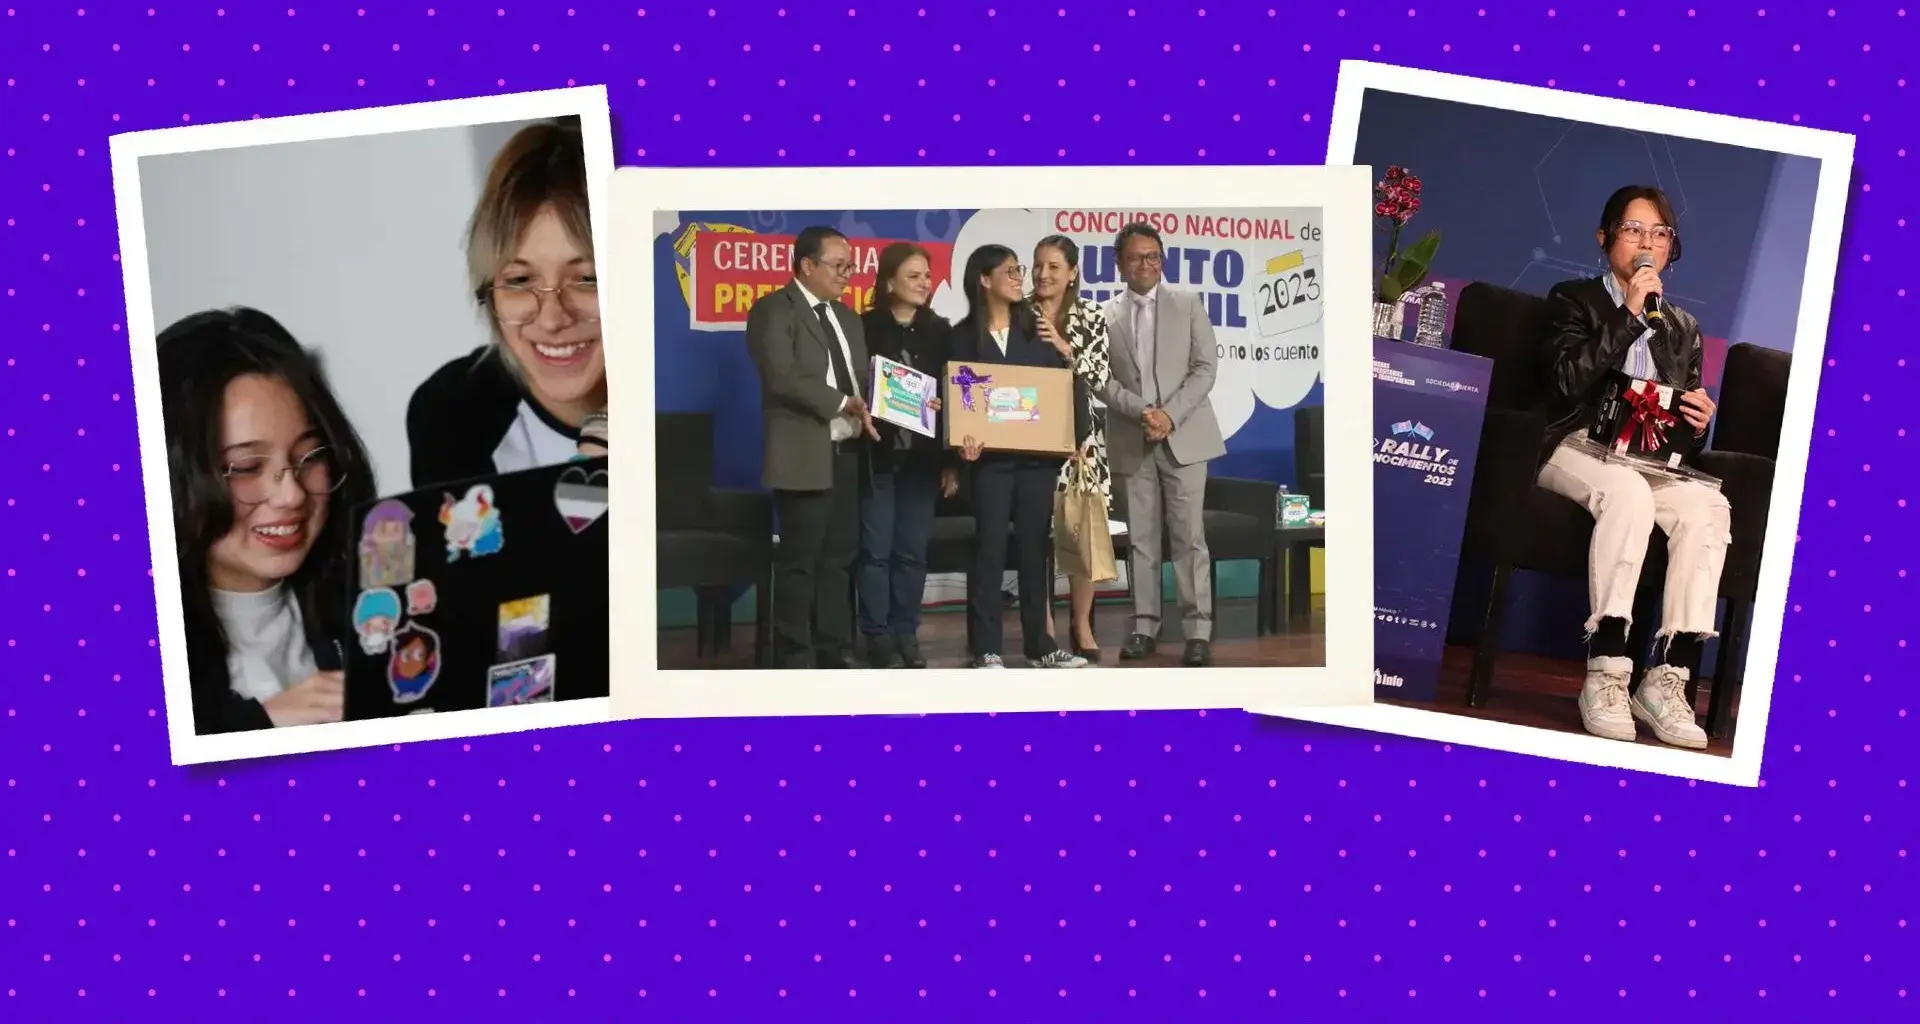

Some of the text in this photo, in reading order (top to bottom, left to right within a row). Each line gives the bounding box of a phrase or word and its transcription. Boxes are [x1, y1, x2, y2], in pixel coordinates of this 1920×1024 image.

[1055, 210, 1321, 242] CONCURSO NACIONAL de
[1258, 268, 1321, 317] 2023
[1229, 344, 1247, 360] no
[1250, 343, 1270, 361] los
[1273, 343, 1319, 361] cuento
[1380, 438, 1460, 466] RALLY DE
[1424, 474, 1454, 487] 2023
